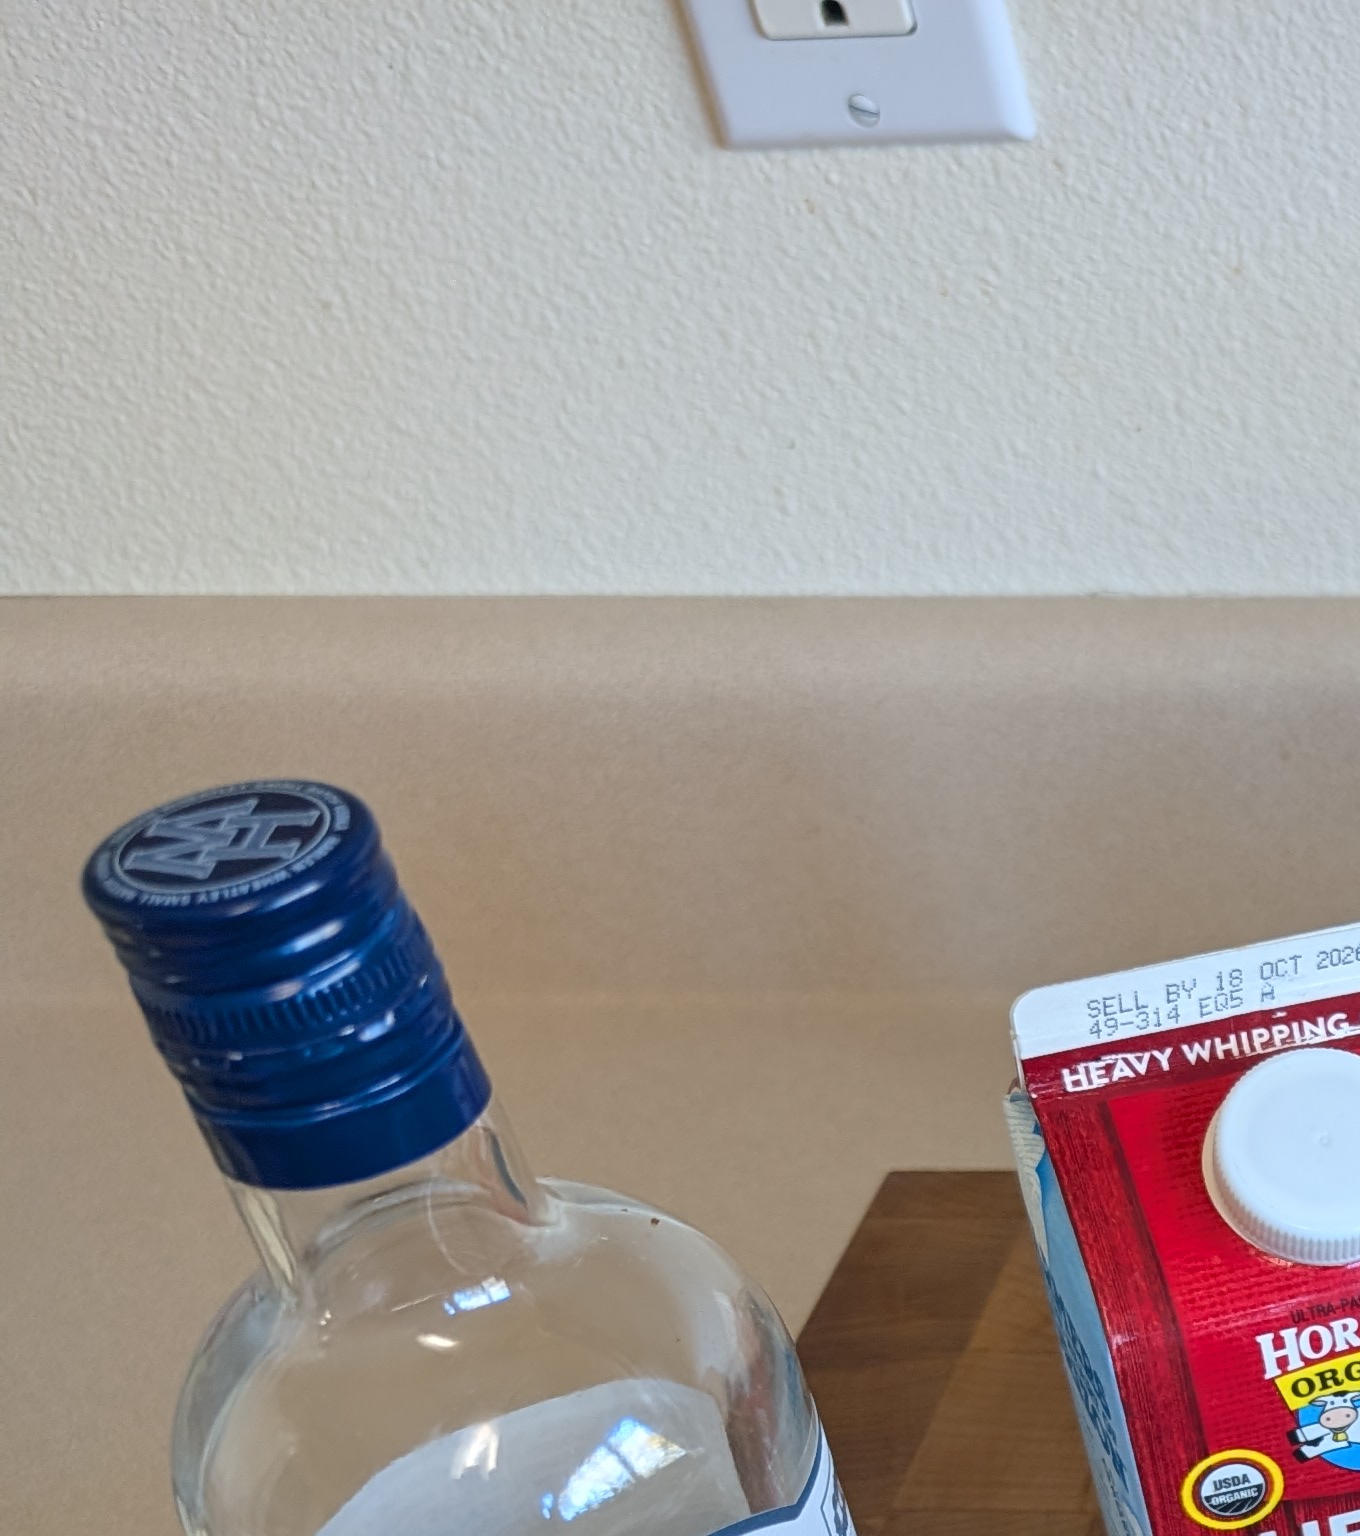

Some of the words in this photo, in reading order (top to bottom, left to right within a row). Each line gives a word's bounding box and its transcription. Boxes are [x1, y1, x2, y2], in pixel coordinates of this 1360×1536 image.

[1087, 990, 1149, 1018] SELL
[1166, 978, 1197, 1005] BY
[1216, 968, 1244, 992] 18
[1259, 955, 1302, 981] OCT
[1089, 1004, 1181, 1040] 49-314
[1061, 1047, 1173, 1093] HEAVY
[1182, 1013, 1349, 1066] WHIPPING
[1210, 1488, 1258, 1505] ORGANIC
[1213, 1473, 1251, 1492] USDA
